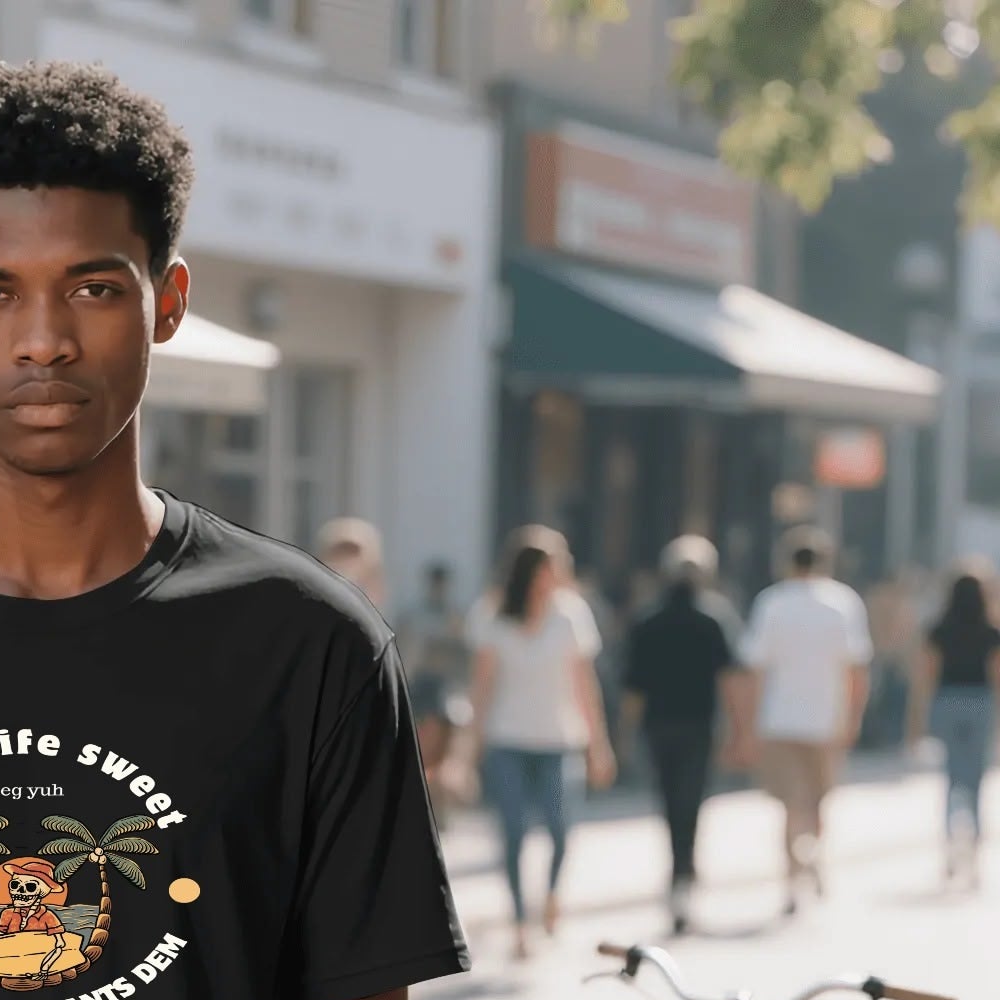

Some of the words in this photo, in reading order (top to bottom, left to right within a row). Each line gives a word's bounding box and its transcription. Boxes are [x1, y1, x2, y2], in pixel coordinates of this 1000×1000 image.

[27, 784, 63, 799] yuh
[77, 744, 187, 829] sweet
[131, 933, 187, 984] DEM
